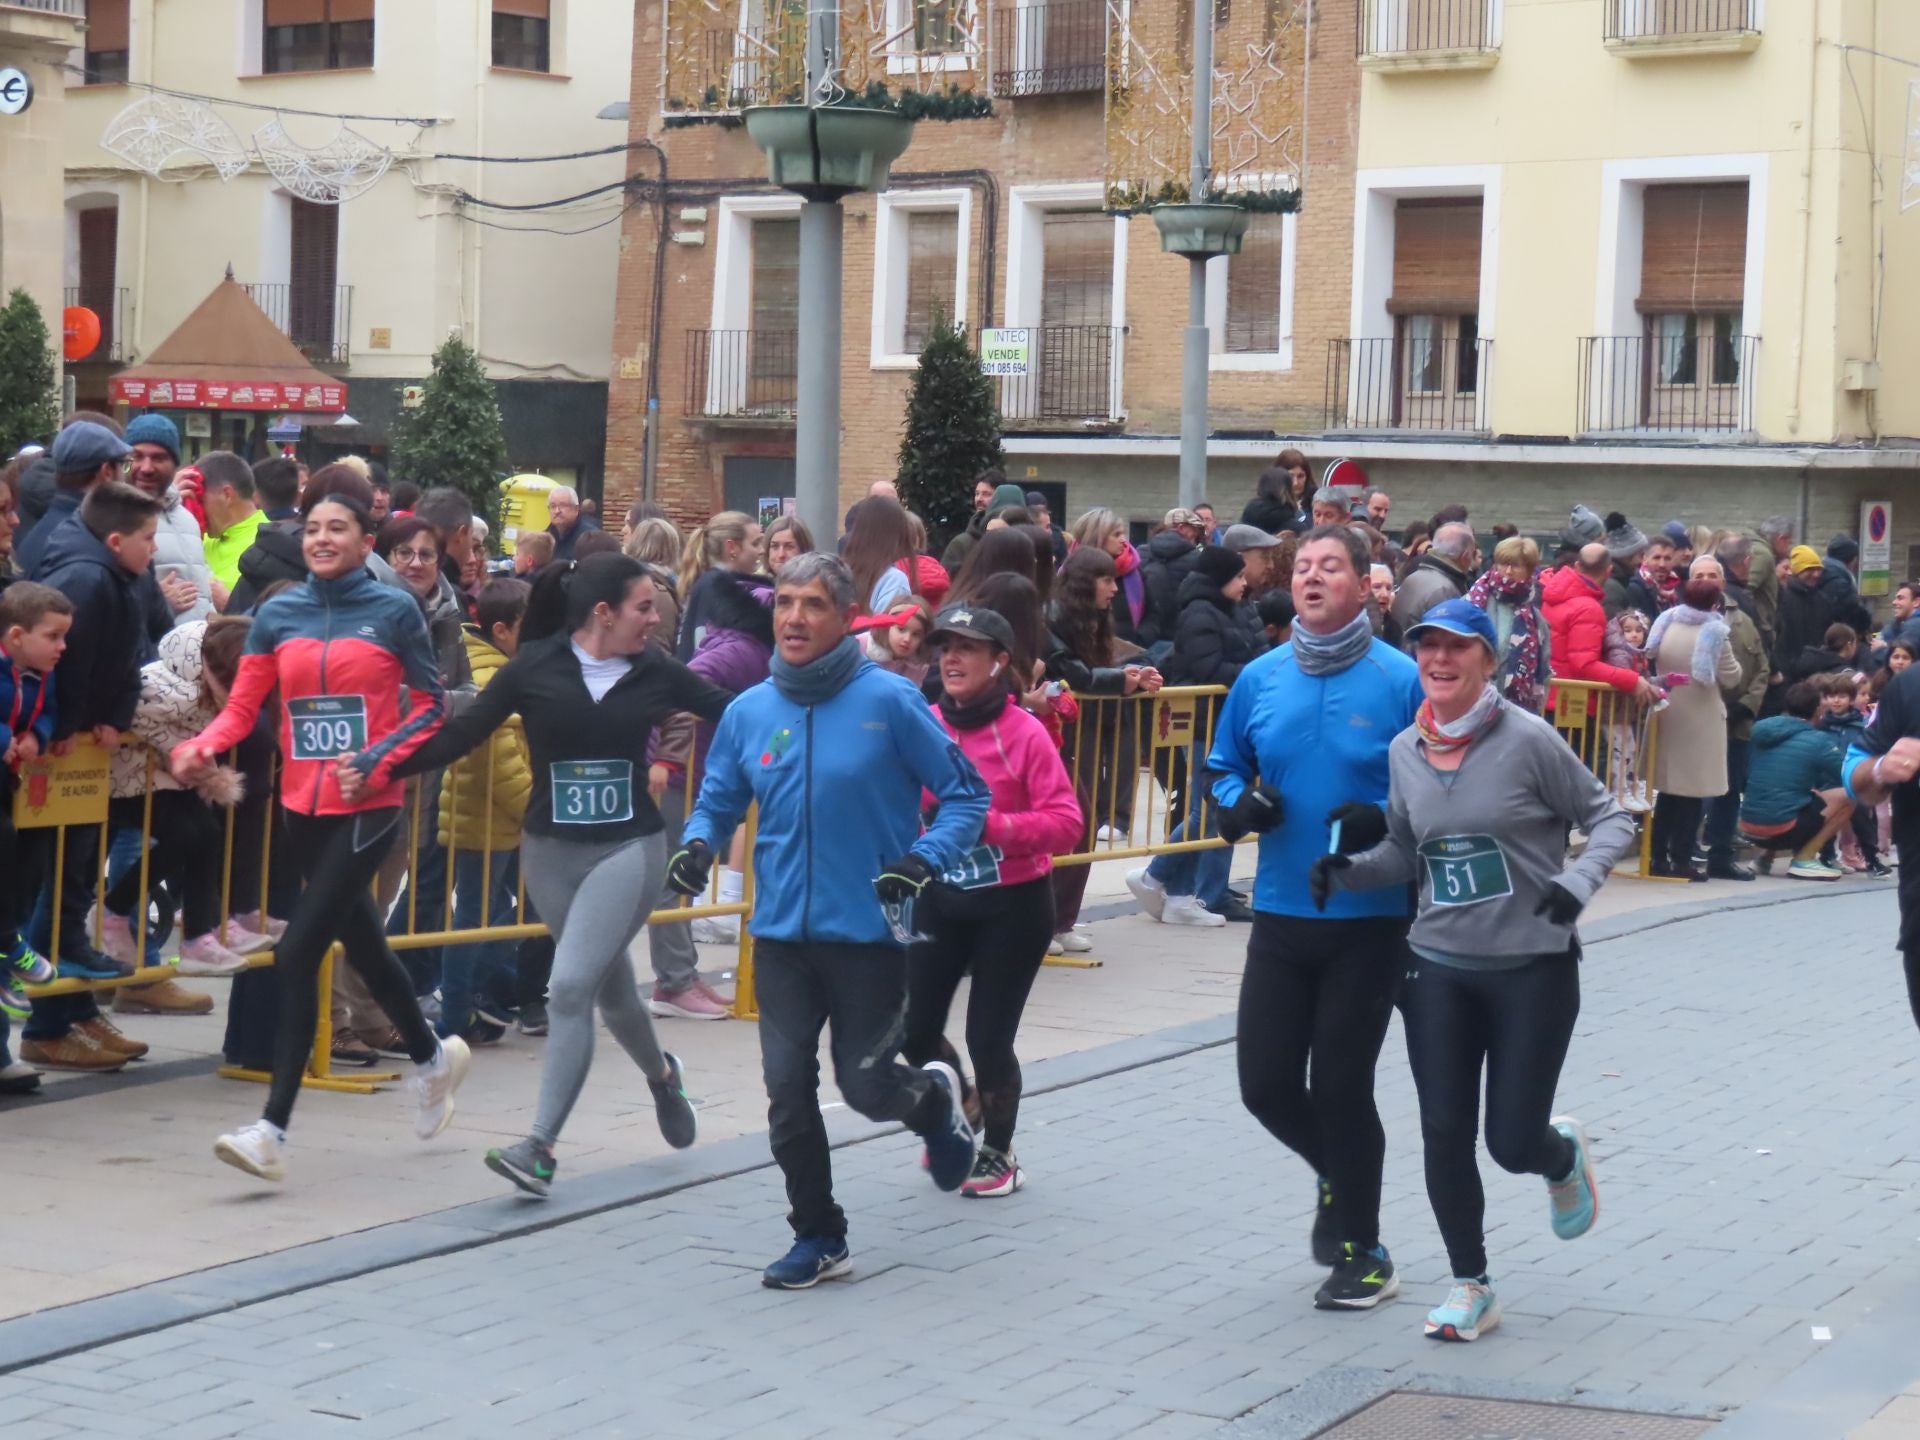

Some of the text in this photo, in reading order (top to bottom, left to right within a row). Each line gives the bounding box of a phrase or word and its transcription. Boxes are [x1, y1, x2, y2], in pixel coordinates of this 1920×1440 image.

[994, 330, 1025, 342] INTEC
[988, 349, 1020, 359] VENDE
[982, 362, 1027, 373] 601 085 694
[302, 720, 352, 751] 309
[61, 785, 72, 797] DE
[567, 785, 618, 815] 310
[1444, 861, 1477, 897] 51
